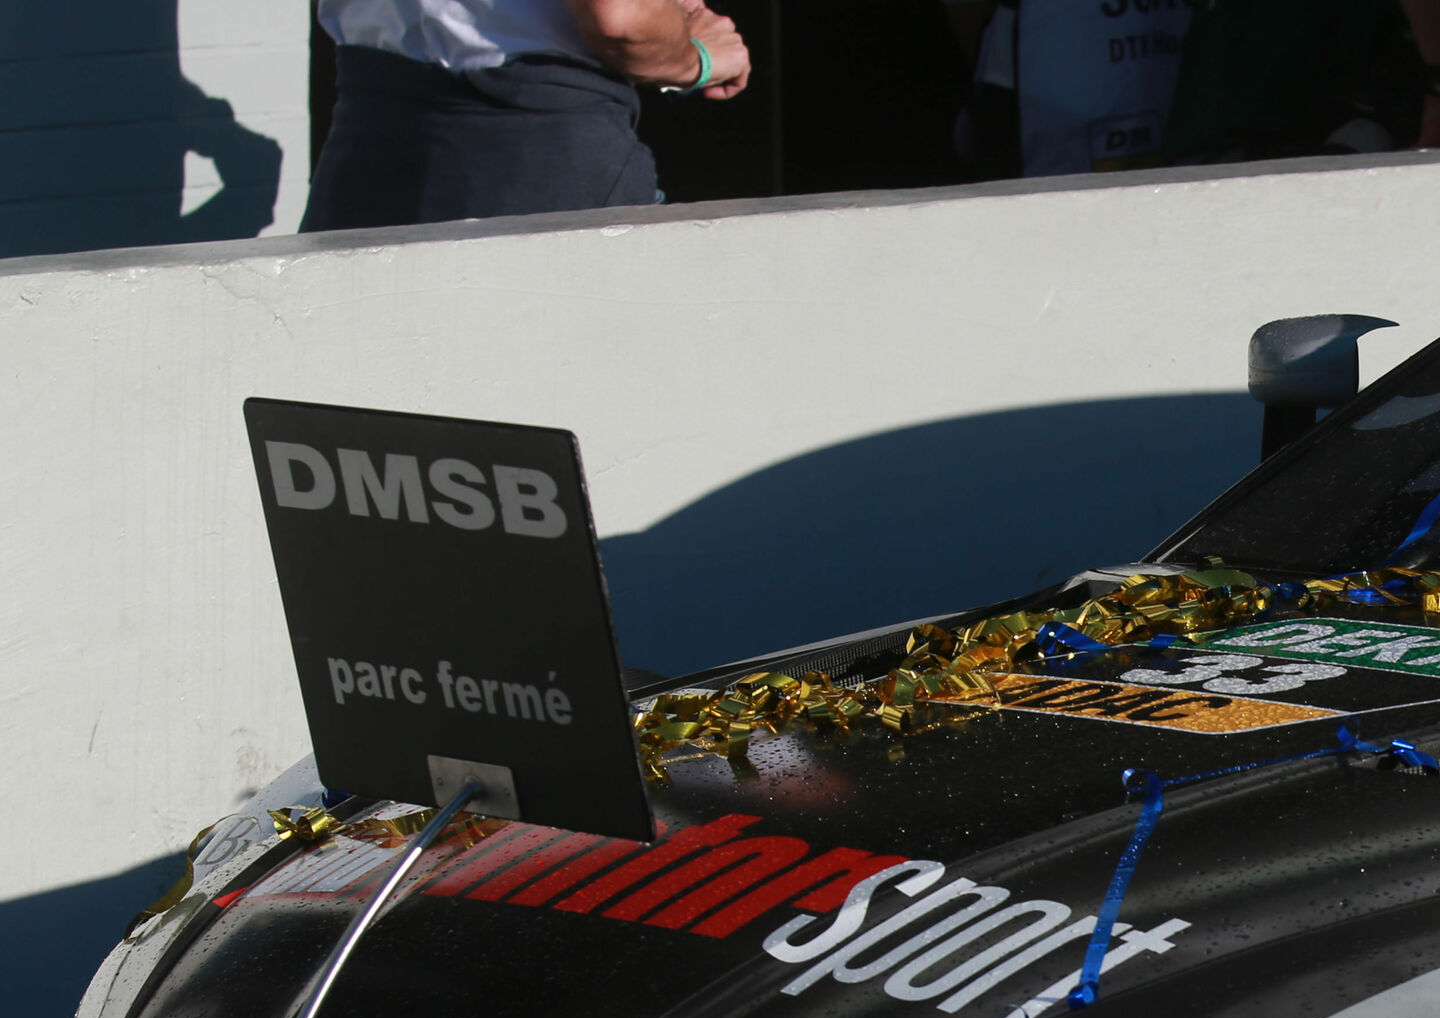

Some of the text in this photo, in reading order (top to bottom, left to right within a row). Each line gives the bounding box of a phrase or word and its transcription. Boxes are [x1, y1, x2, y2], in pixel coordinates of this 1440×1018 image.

[264, 440, 568, 539] DMSB
[327, 656, 574, 726] parc fermé
[1119, 653, 1348, 696] 33
